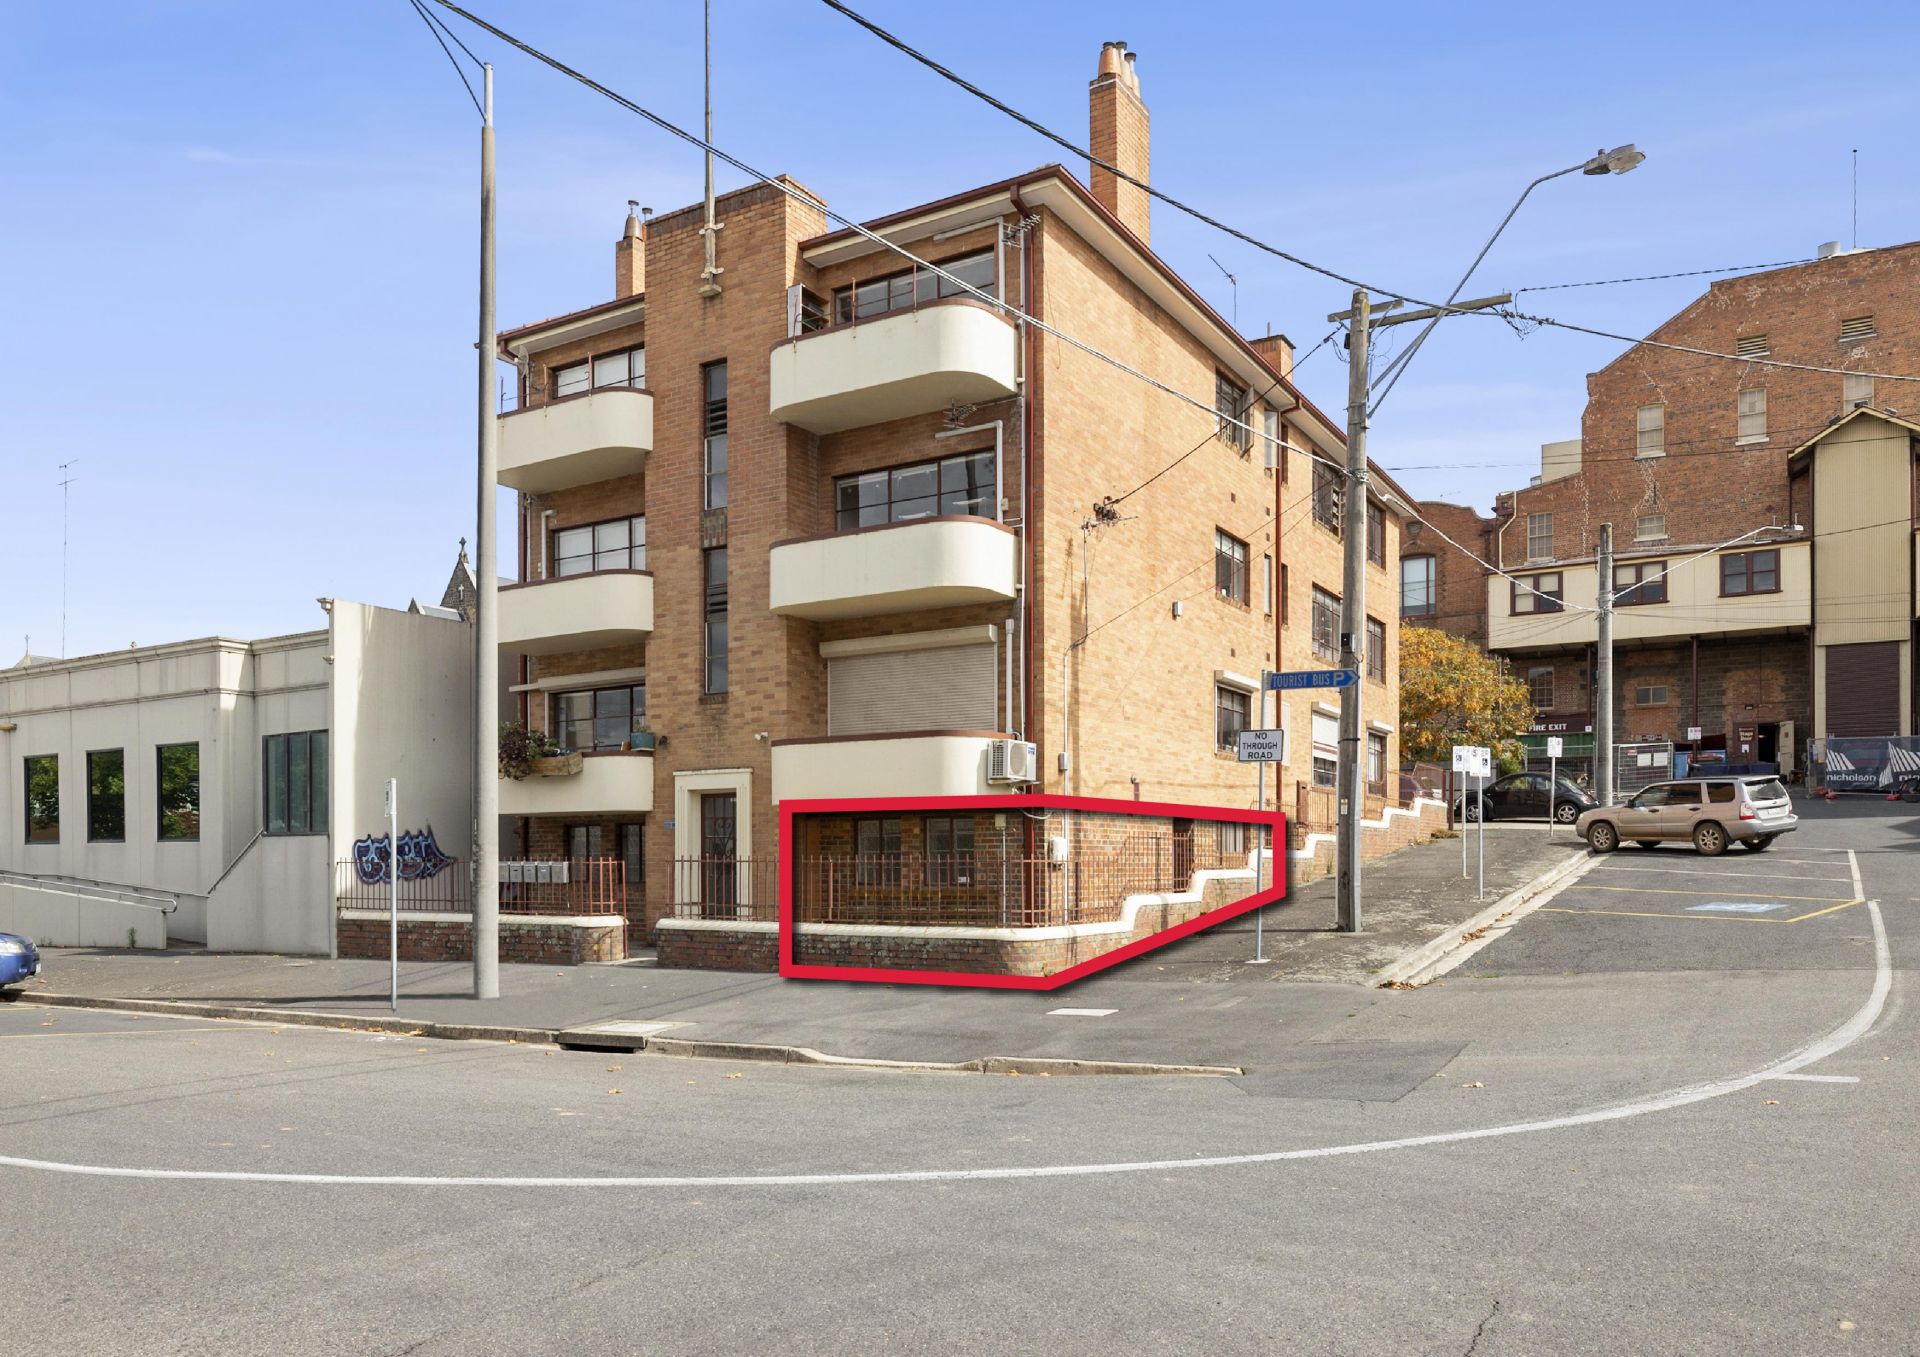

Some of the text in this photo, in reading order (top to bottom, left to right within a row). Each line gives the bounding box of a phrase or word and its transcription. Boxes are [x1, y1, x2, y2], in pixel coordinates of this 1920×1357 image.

[1272, 672, 1345, 688] TOURIST BUS P
[1548, 723, 1567, 731] EXIT
[1254, 732, 1268, 740] NO
[1242, 742, 1278, 750] THROUGH
[1247, 751, 1273, 759] ROAD
[1826, 773, 1877, 782] nicholson
